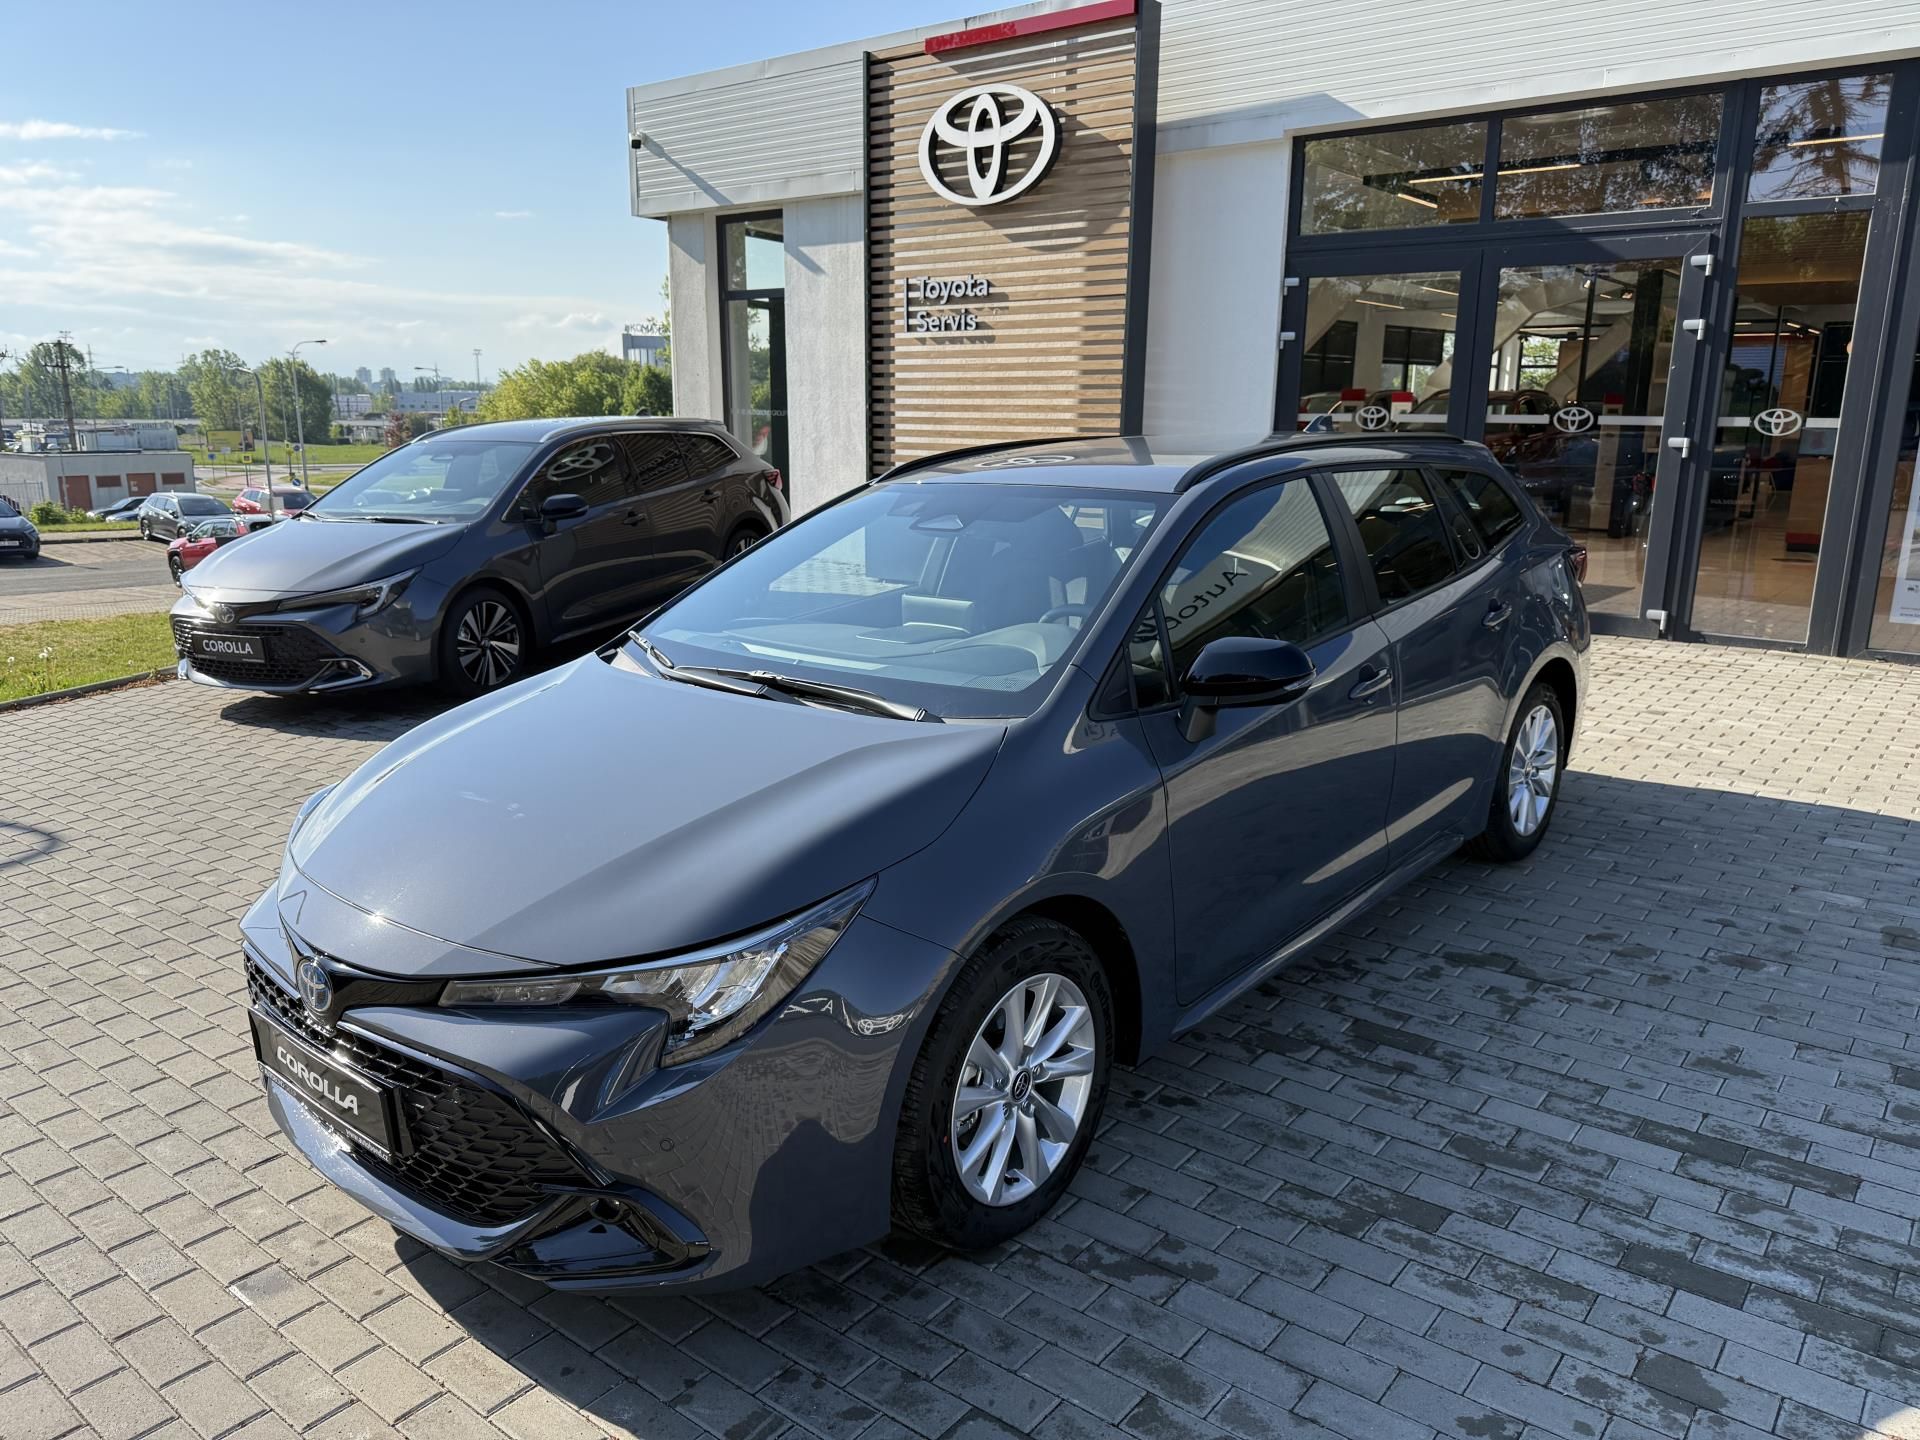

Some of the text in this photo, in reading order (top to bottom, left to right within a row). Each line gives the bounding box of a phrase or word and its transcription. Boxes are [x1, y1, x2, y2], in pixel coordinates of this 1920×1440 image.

[916, 273, 988, 304] Toyota
[916, 309, 977, 332] Servis
[202, 639, 254, 655] COROLLA
[276, 1045, 359, 1116] COROLLA
